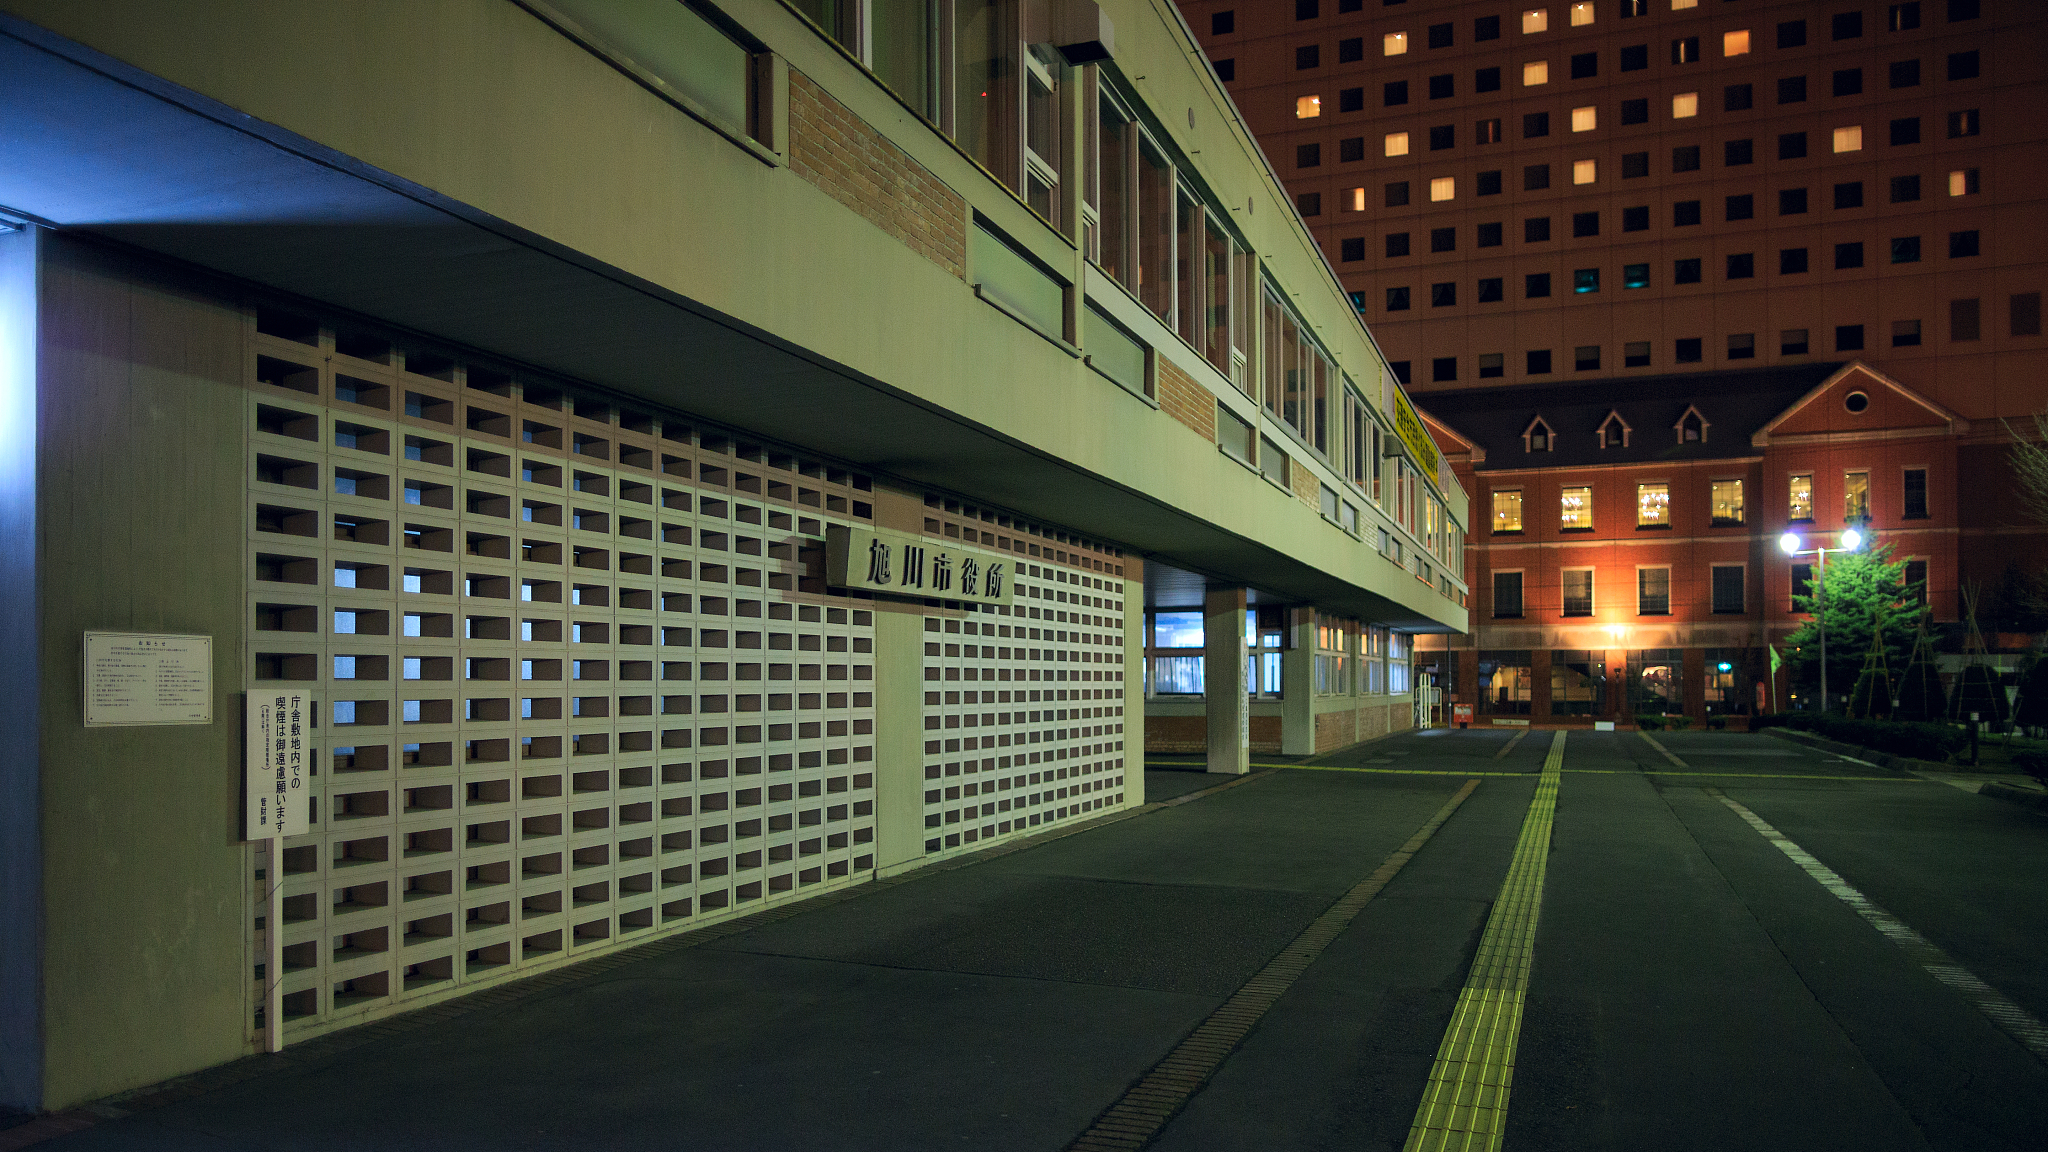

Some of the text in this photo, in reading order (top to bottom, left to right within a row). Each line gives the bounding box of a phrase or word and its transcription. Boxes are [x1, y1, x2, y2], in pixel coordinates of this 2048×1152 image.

[867, 538, 1005, 599] 旭川市役所
[275, 696, 286, 833] 喫煙は御遠慮願います
[290, 695, 301, 789] 庁舎敷地内での
